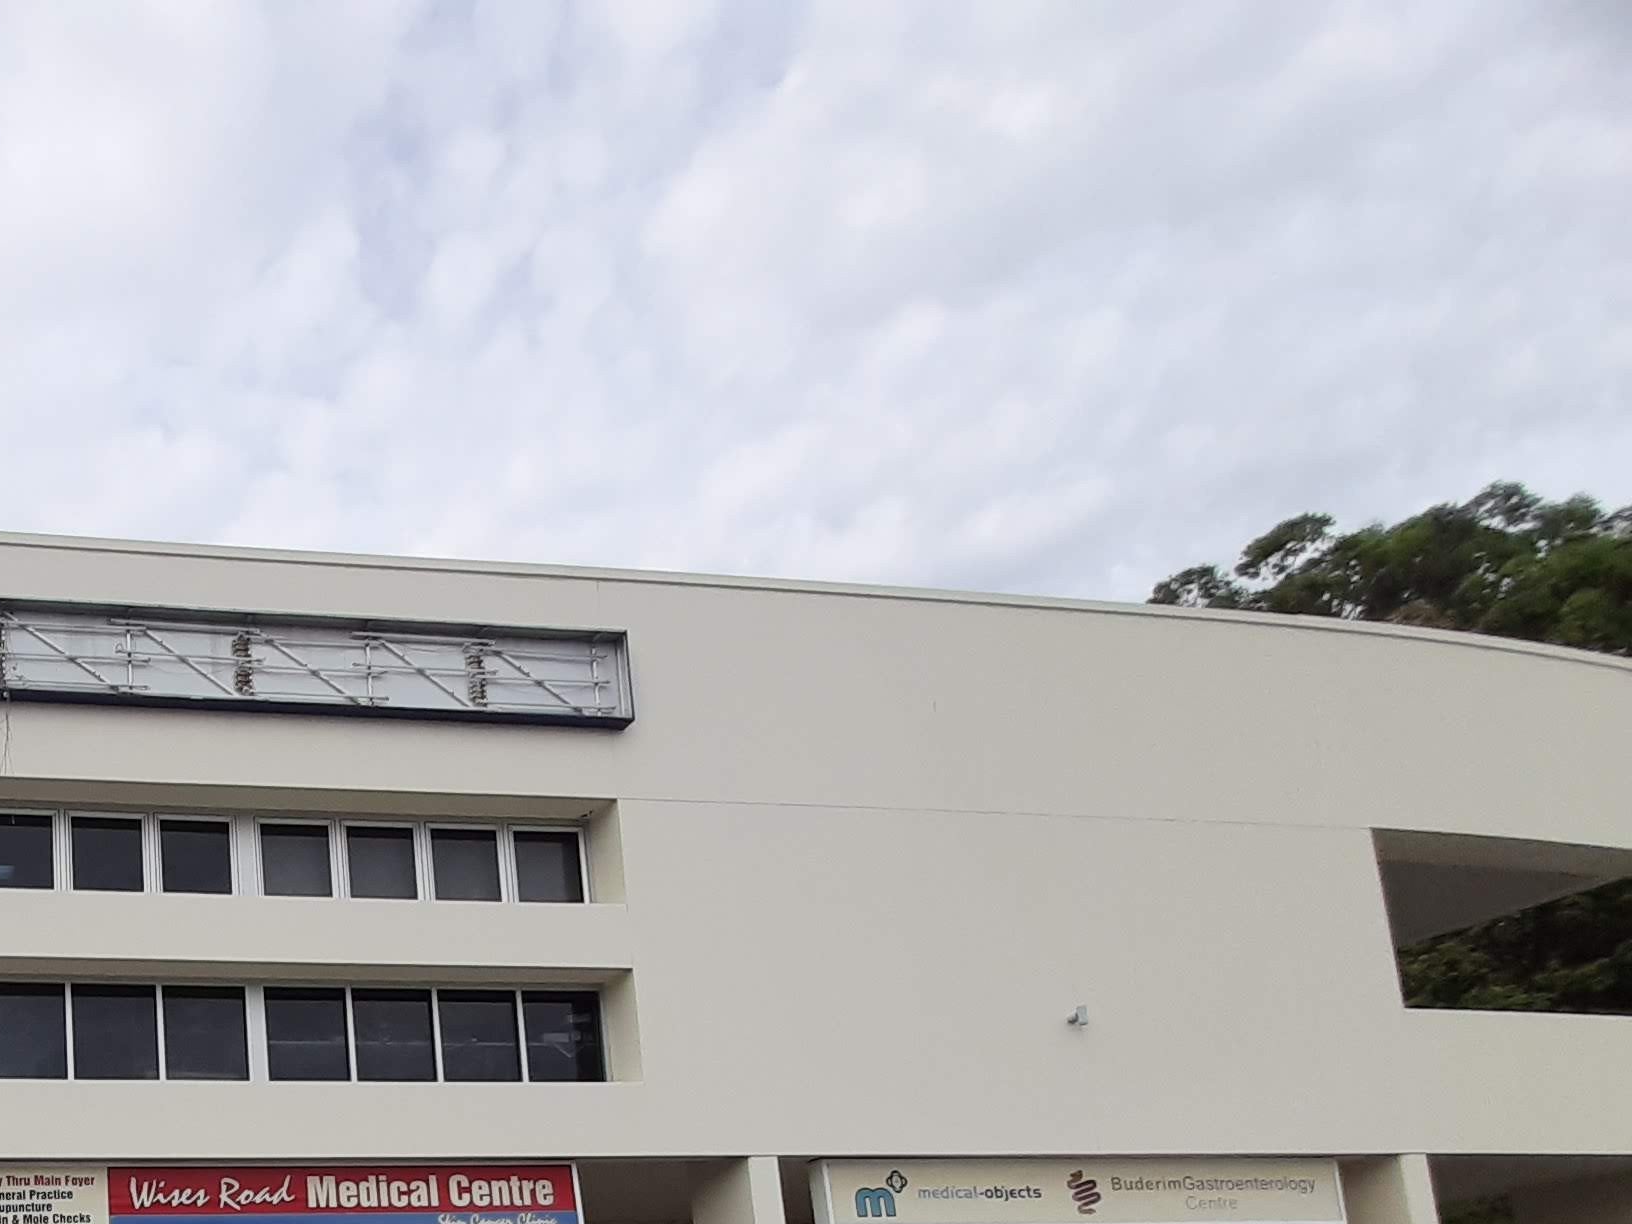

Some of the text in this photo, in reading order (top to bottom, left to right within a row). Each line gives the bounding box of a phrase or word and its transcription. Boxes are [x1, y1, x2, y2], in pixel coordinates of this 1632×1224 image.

[6, 1175, 30, 1186] Thru
[34, 1175, 61, 1186] Main
[65, 1175, 95, 1187] Foyer
[29, 1190, 73, 1200] Practice
[130, 1174, 554, 1211] Wises Road Medical Centre
[918, 1185, 1042, 1201] medical-objects
[1185, 1195, 1238, 1209] Centre
[12, 1215, 19, 1224] &
[23, 1214, 49, 1224] Mole
[53, 1213, 91, 1224] Checks
